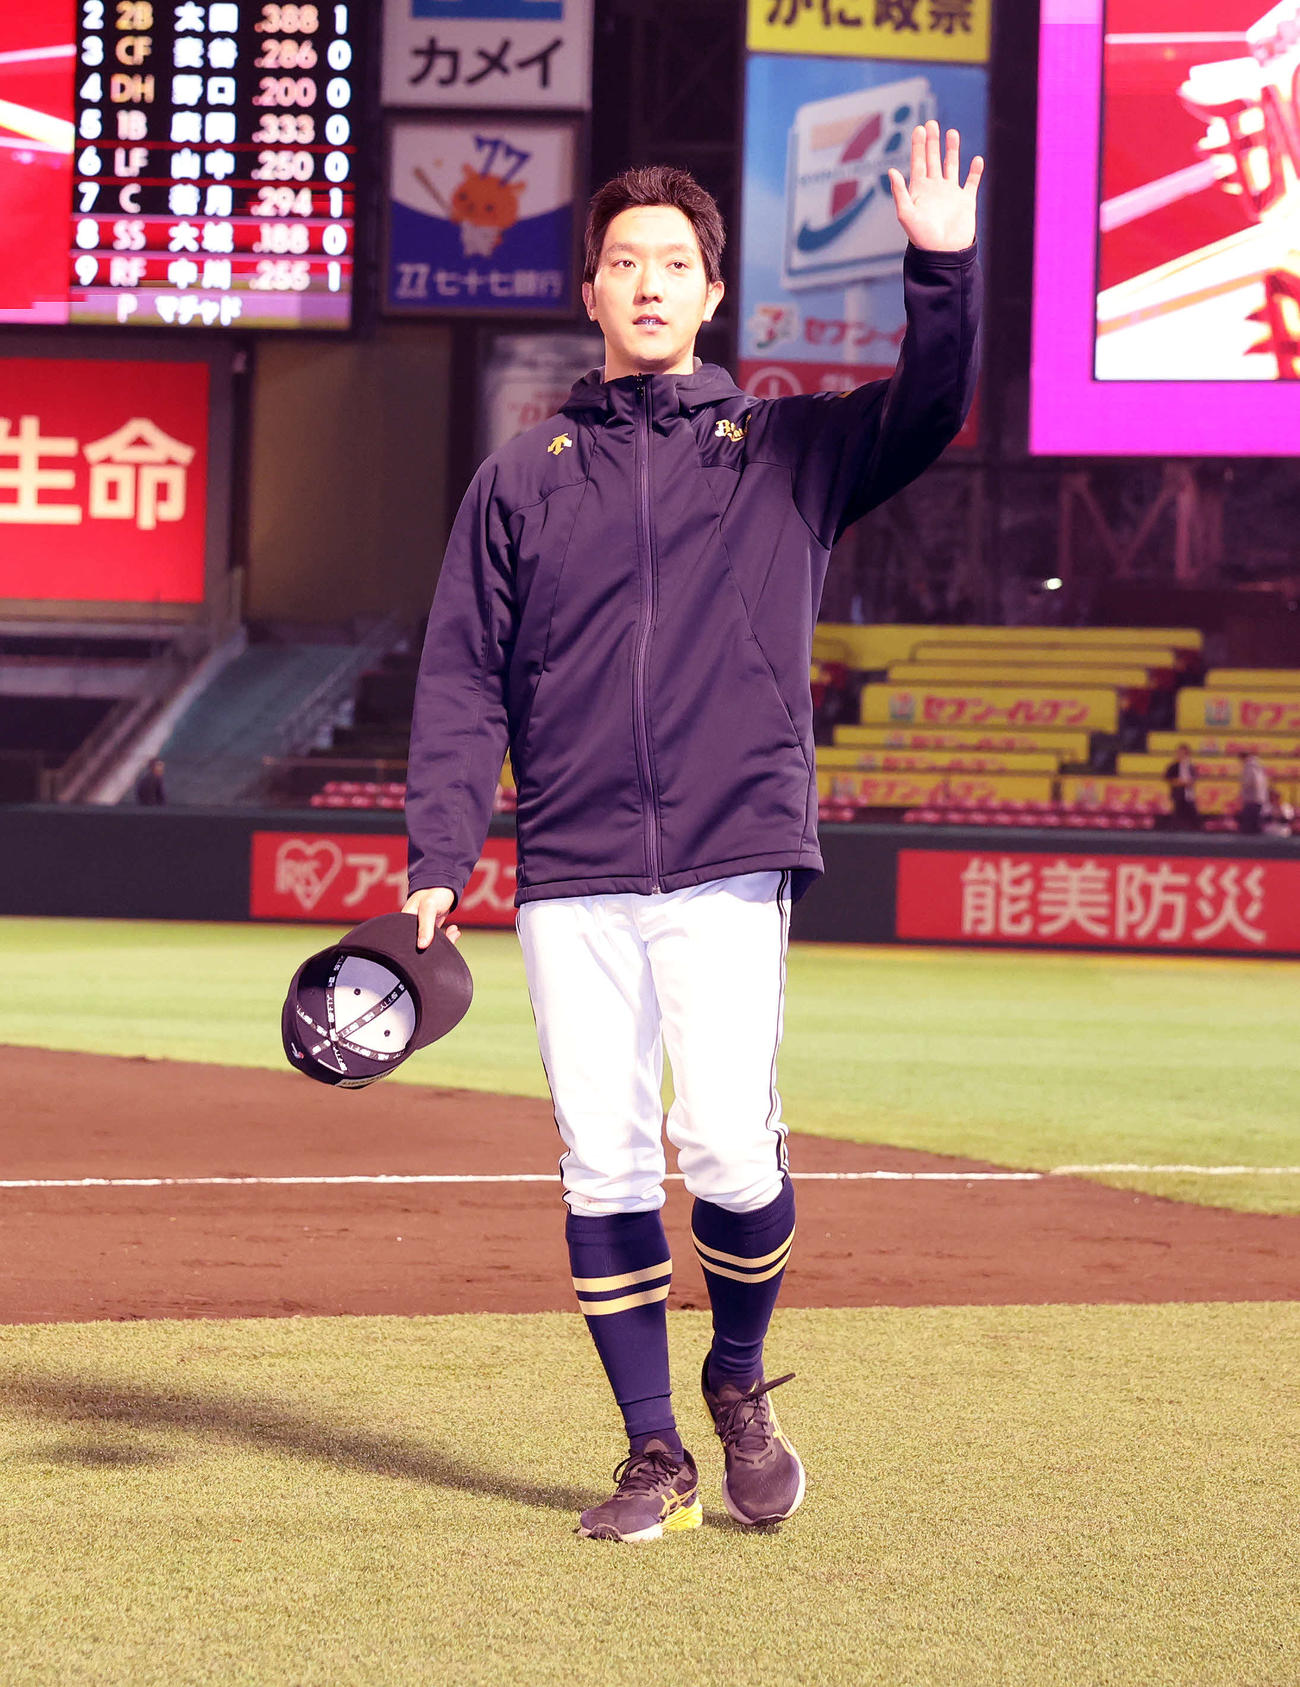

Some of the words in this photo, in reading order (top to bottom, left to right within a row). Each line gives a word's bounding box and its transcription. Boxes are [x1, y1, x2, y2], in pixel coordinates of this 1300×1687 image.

[83, 0, 104, 30] 2
[334, 4, 348, 35] 1
[81, 36, 104, 66] 3
[115, 36, 152, 66] CF
[254, 39, 318, 69] .286
[327, 39, 352, 71] 0
[410, 36, 563, 89] カメイ
[80, 73, 103, 103] 4
[110, 74, 155, 103] DH
[252, 76, 317, 107] .200
[326, 76, 351, 108] 0
[79, 109, 102, 140] 5
[252, 113, 316, 144] .333
[325, 114, 350, 146] 0
[78, 146, 102, 176] 6
[114, 148, 148, 177] LF
[324, 150, 350, 182] 0
[79, 182, 100, 212] 7
[119, 183, 141, 214] C
[329, 187, 343, 218] 1
[76, 218, 99, 249] 8
[113, 219, 147, 250] SS
[322, 224, 348, 256] 0
[74, 255, 98, 286] 9
[327, 260, 341, 292] 1
[117, 293, 138, 323] P
[0, 414, 196, 531] 生命
[960, 856, 1268, 945] 能美防災
